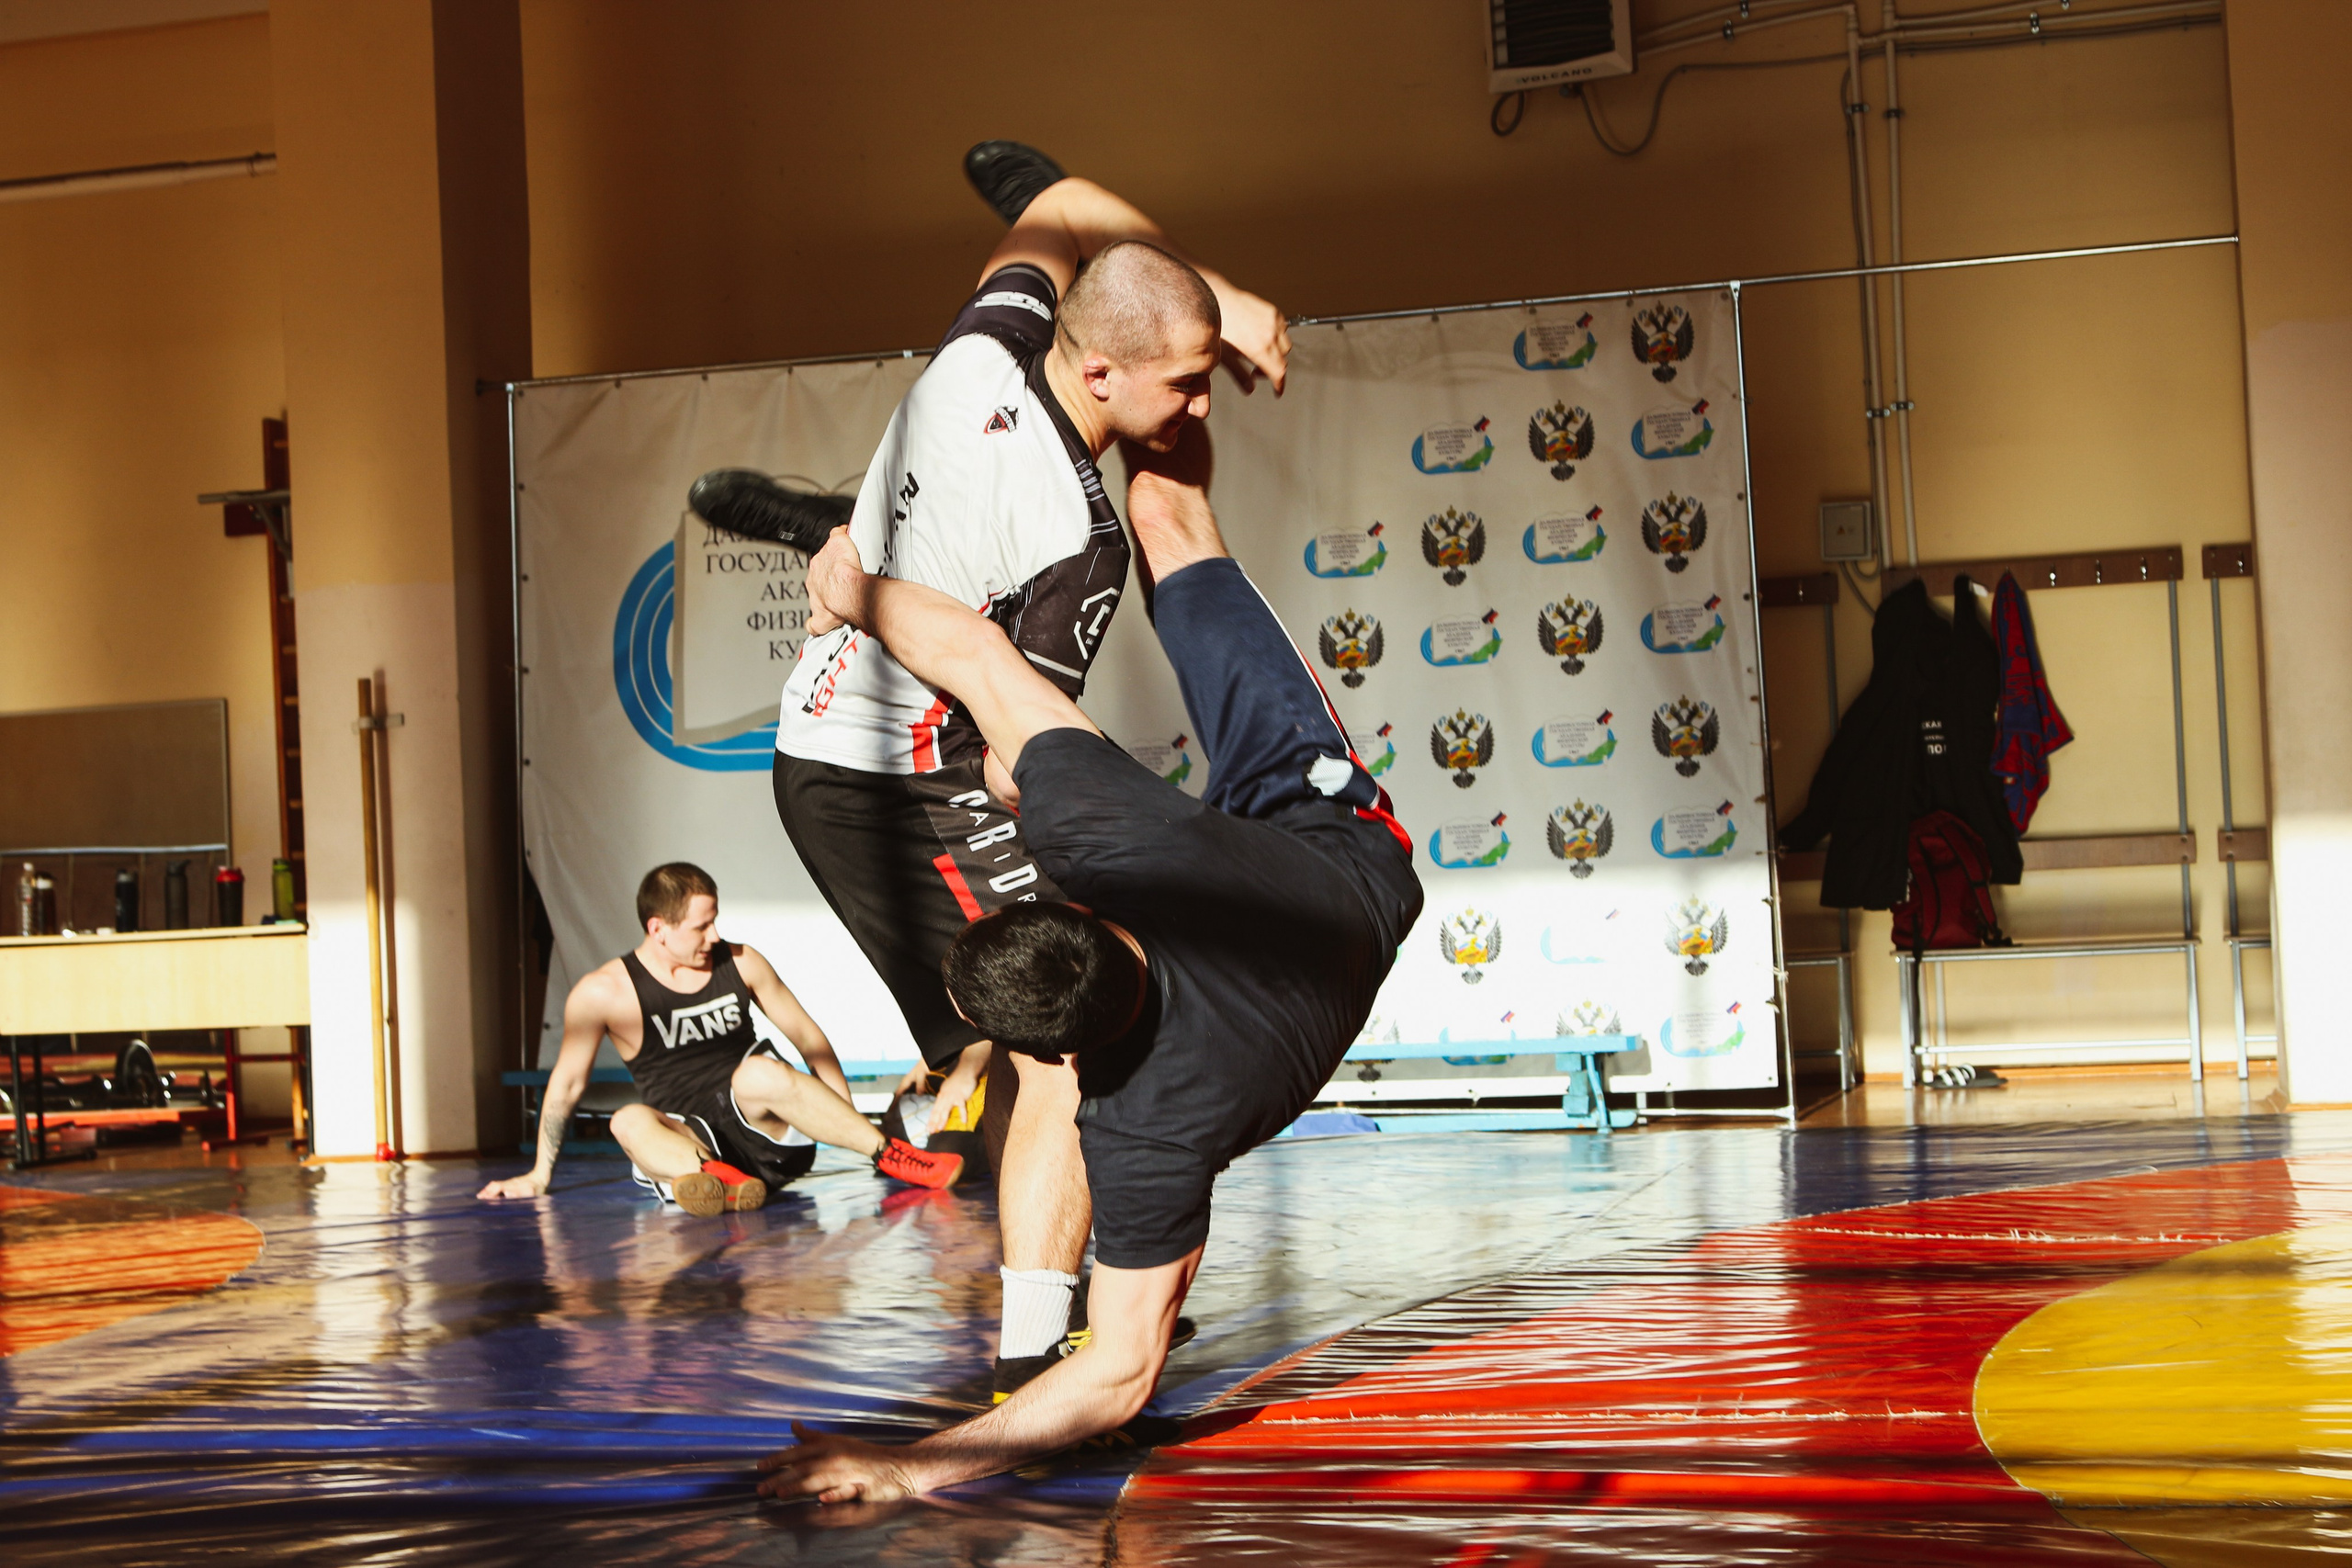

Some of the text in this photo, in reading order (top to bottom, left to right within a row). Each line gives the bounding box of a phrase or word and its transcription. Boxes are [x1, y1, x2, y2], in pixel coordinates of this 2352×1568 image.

[1521, 67, 1593, 84] VOLCANO
[706, 550, 810, 574] ГОСУДА
[769, 638, 806, 660] КУ
[650, 991, 742, 1050] VANS
